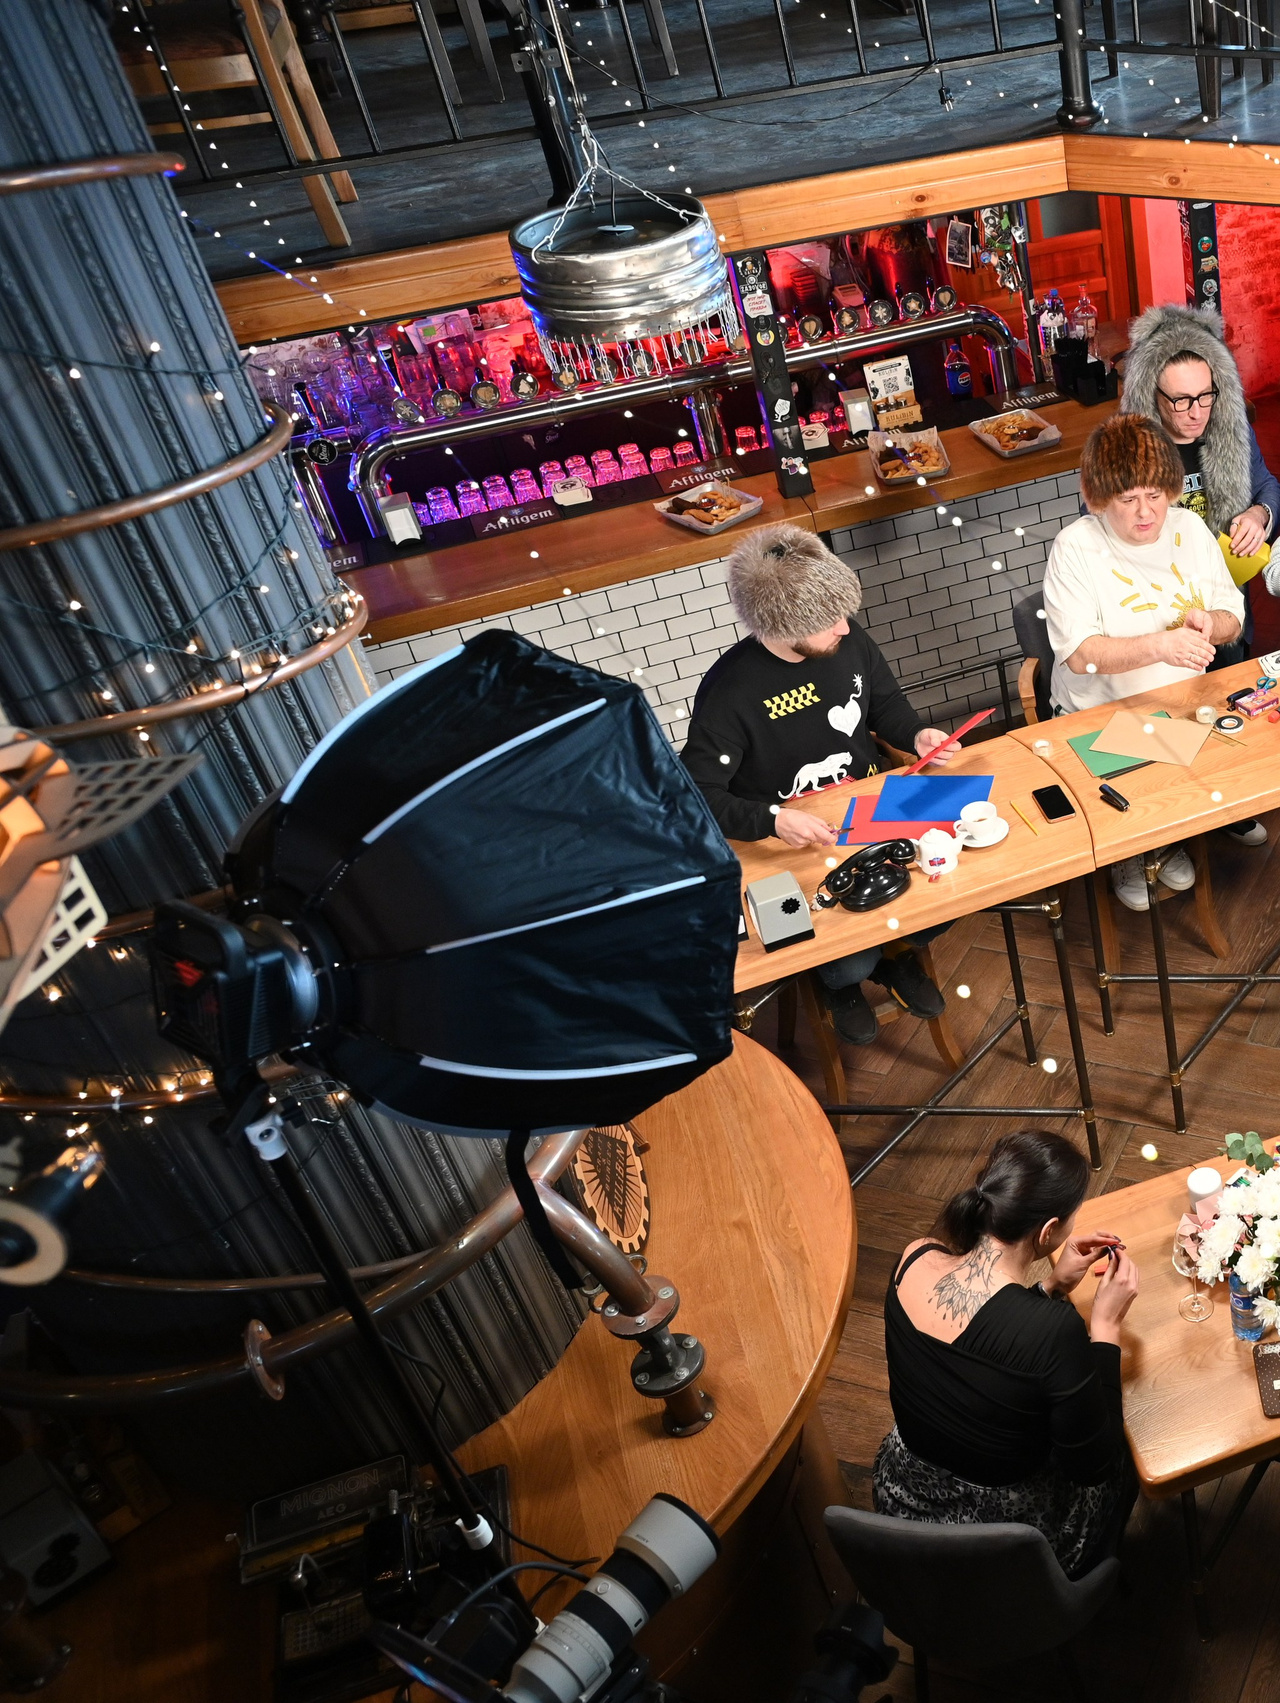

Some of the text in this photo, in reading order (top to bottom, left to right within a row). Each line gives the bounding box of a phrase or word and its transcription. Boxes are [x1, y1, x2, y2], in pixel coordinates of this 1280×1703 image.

[1002, 391, 1060, 410] Affligem
[669, 467, 737, 489] Affligem
[482, 509, 555, 533] Affligem
[596, 1136, 604, 1174] CRAFT
[605, 1141, 613, 1192] BURGER
[280, 1468, 380, 1517] MIGNON
[317, 1502, 347, 1521] AEG
